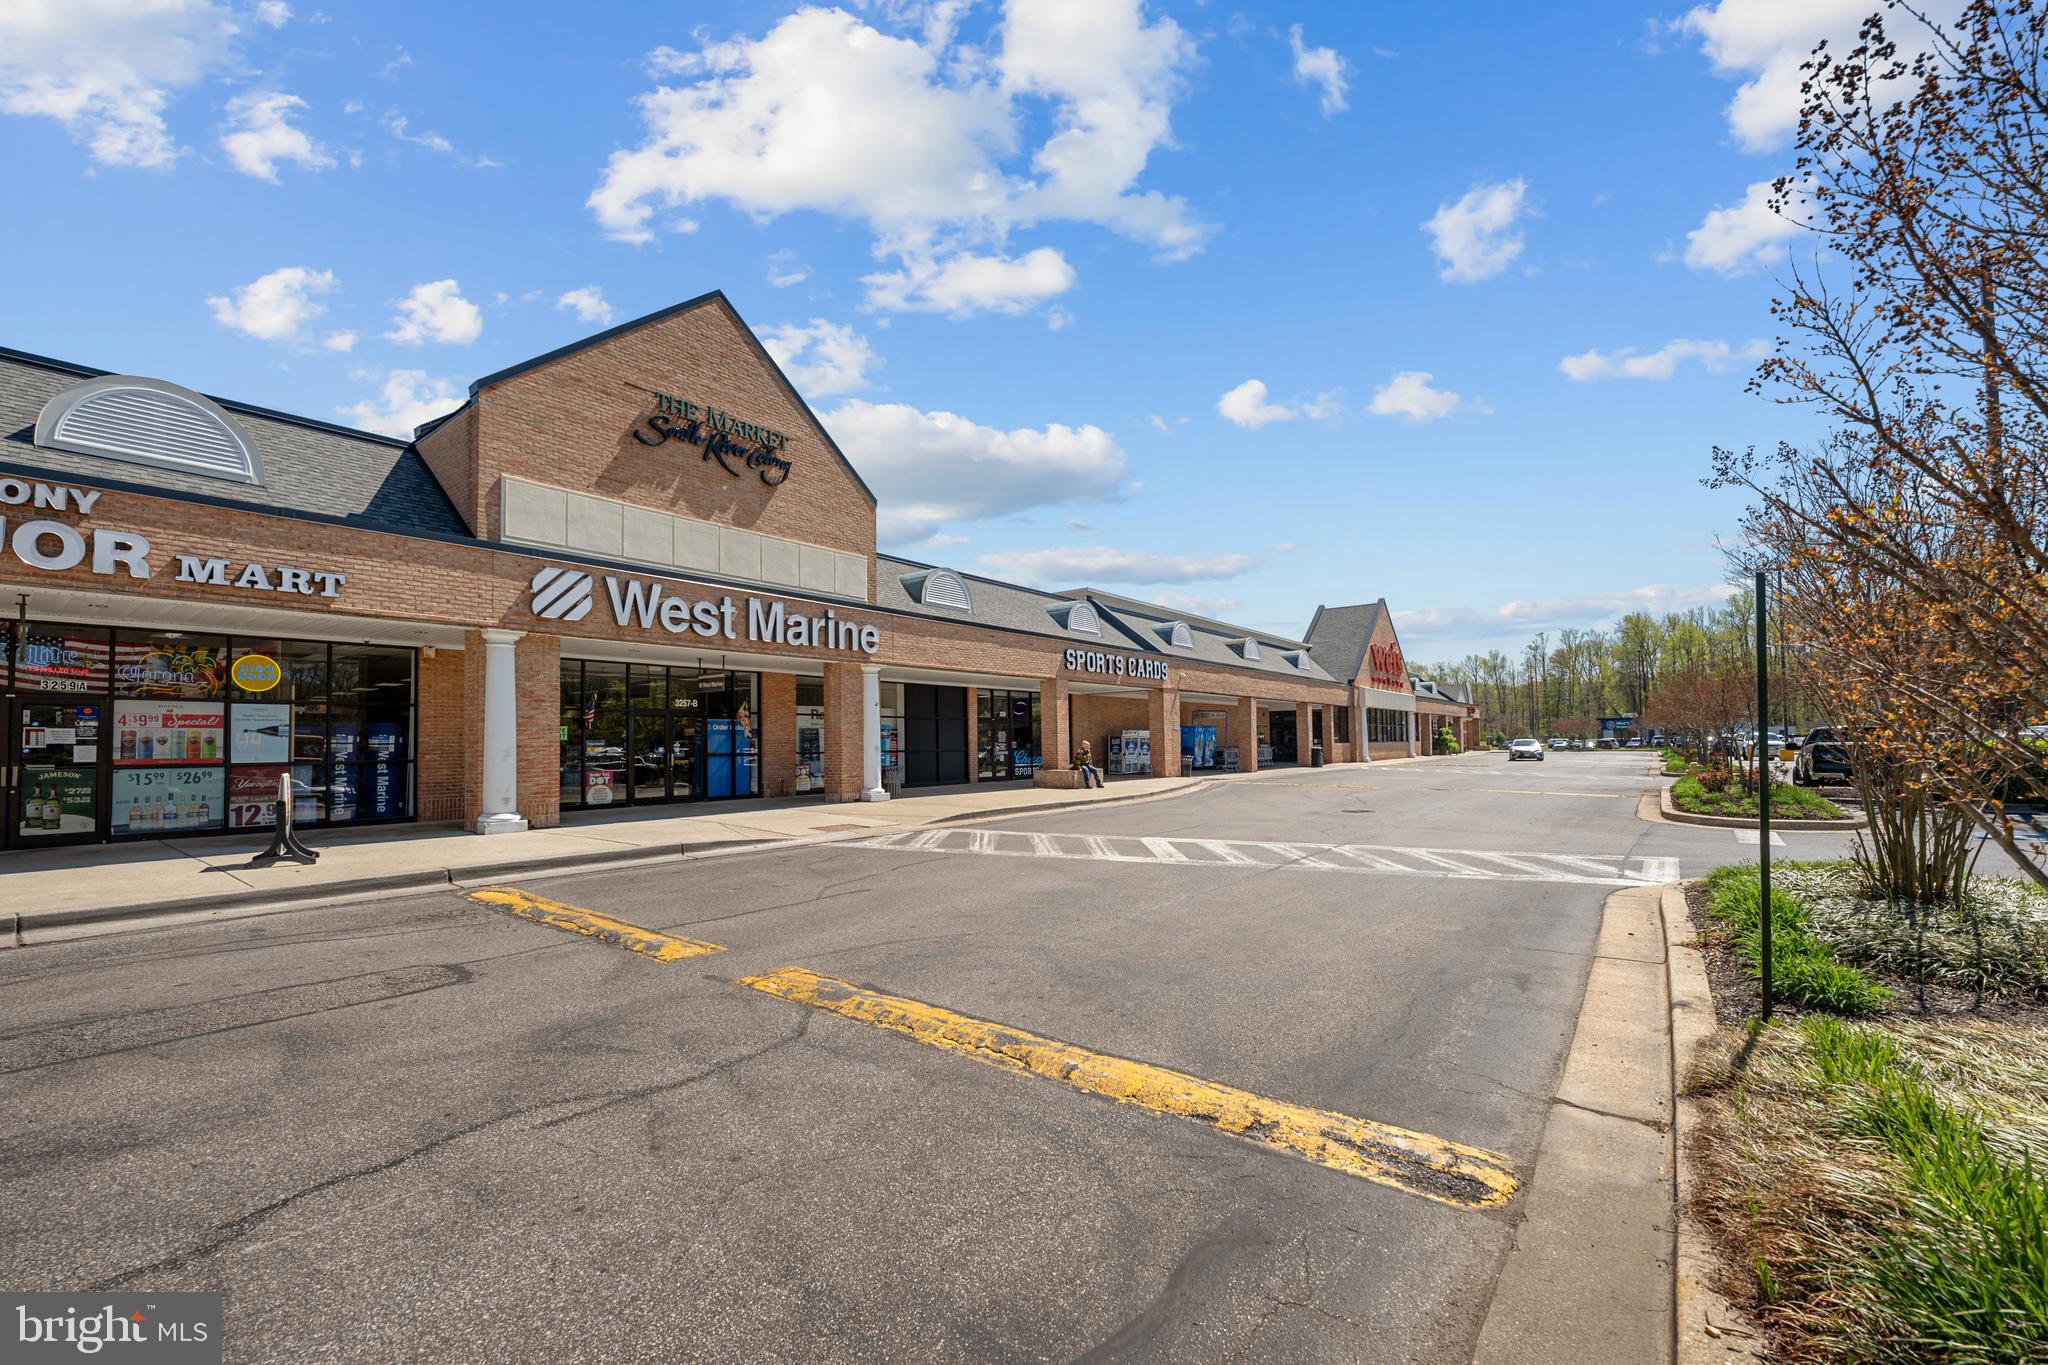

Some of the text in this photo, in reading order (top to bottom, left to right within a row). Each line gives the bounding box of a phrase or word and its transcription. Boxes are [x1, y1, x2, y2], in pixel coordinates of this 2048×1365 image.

[634, 416, 706, 447] South
[656, 391, 789, 451] THE MARKET
[175, 554, 346, 599] MART
[603, 575, 880, 654] West Marine
[117, 664, 194, 687] Corona
[1064, 648, 1169, 680] SPORTS CARDS
[41, 680, 87, 691] 3259A
[675, 699, 698, 708] 3257-B
[118, 714, 128, 726] 4
[168, 713, 220, 728] Special!
[38, 771, 81, 780] JAMESON
[335, 777, 348, 815] Marine
[377, 776, 389, 813] Marine
